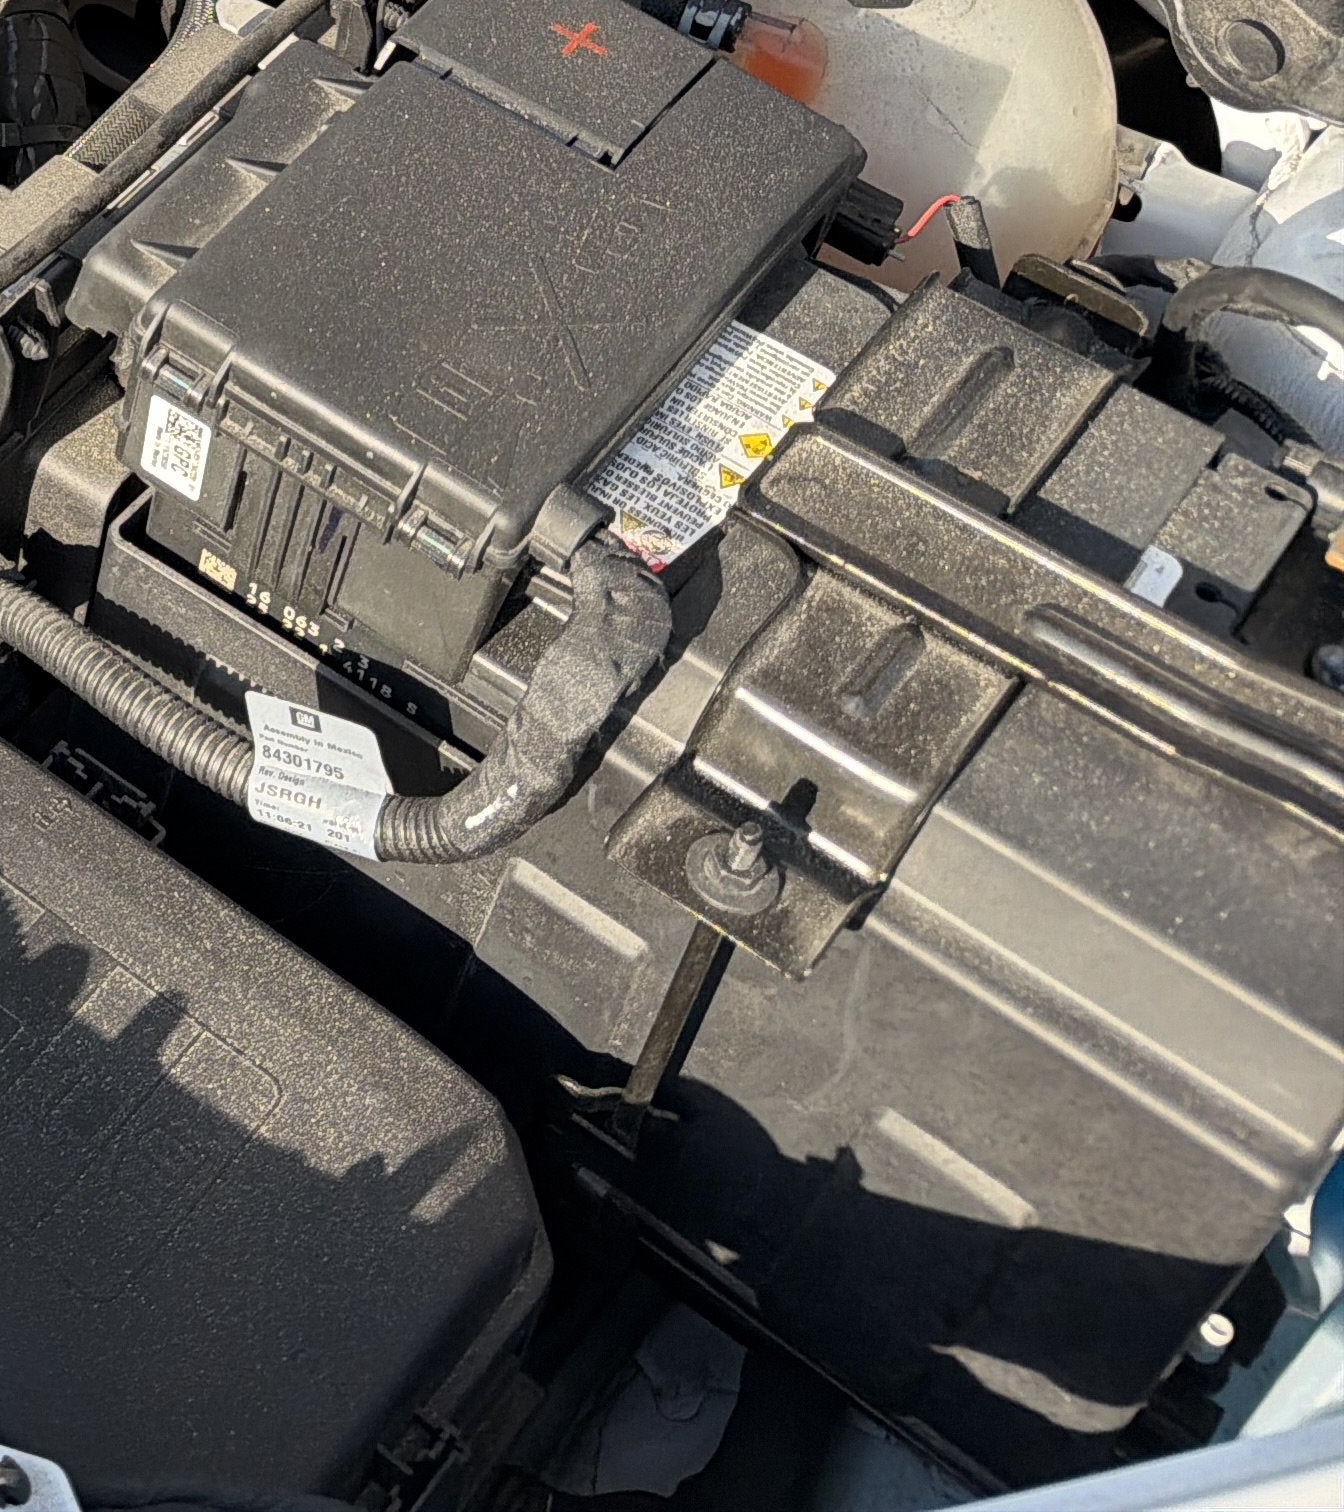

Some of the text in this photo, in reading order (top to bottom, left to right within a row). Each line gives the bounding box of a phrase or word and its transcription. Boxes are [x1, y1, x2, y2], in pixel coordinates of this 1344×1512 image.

[665, 404, 685, 417] LES
[669, 395, 686, 408] UN
[666, 417, 693, 435] EYES
[169, 444, 192, 478] GPC
[633, 435, 708, 480] SULFURIC ACID
[612, 473, 659, 502] BLESSER
[637, 475, 662, 492] LOS
[617, 488, 641, 505] LES
[659, 488, 714, 521] PROTEJA
[655, 498, 705, 529] PEUVENT
[672, 519, 697, 536] LES
[248, 582, 369, 670] 16 063 2 3
[343, 661, 393, 699] 4118
[295, 711, 315, 728] GM
[259, 733, 308, 753] Part Number
[263, 724, 310, 745] Assembly
[327, 742, 363, 760] Mexico
[262, 744, 345, 780] 84301795
[258, 766, 305, 786] Rev. Design
[254, 782, 322, 810] JSRGH
[327, 828, 351, 843] 201
